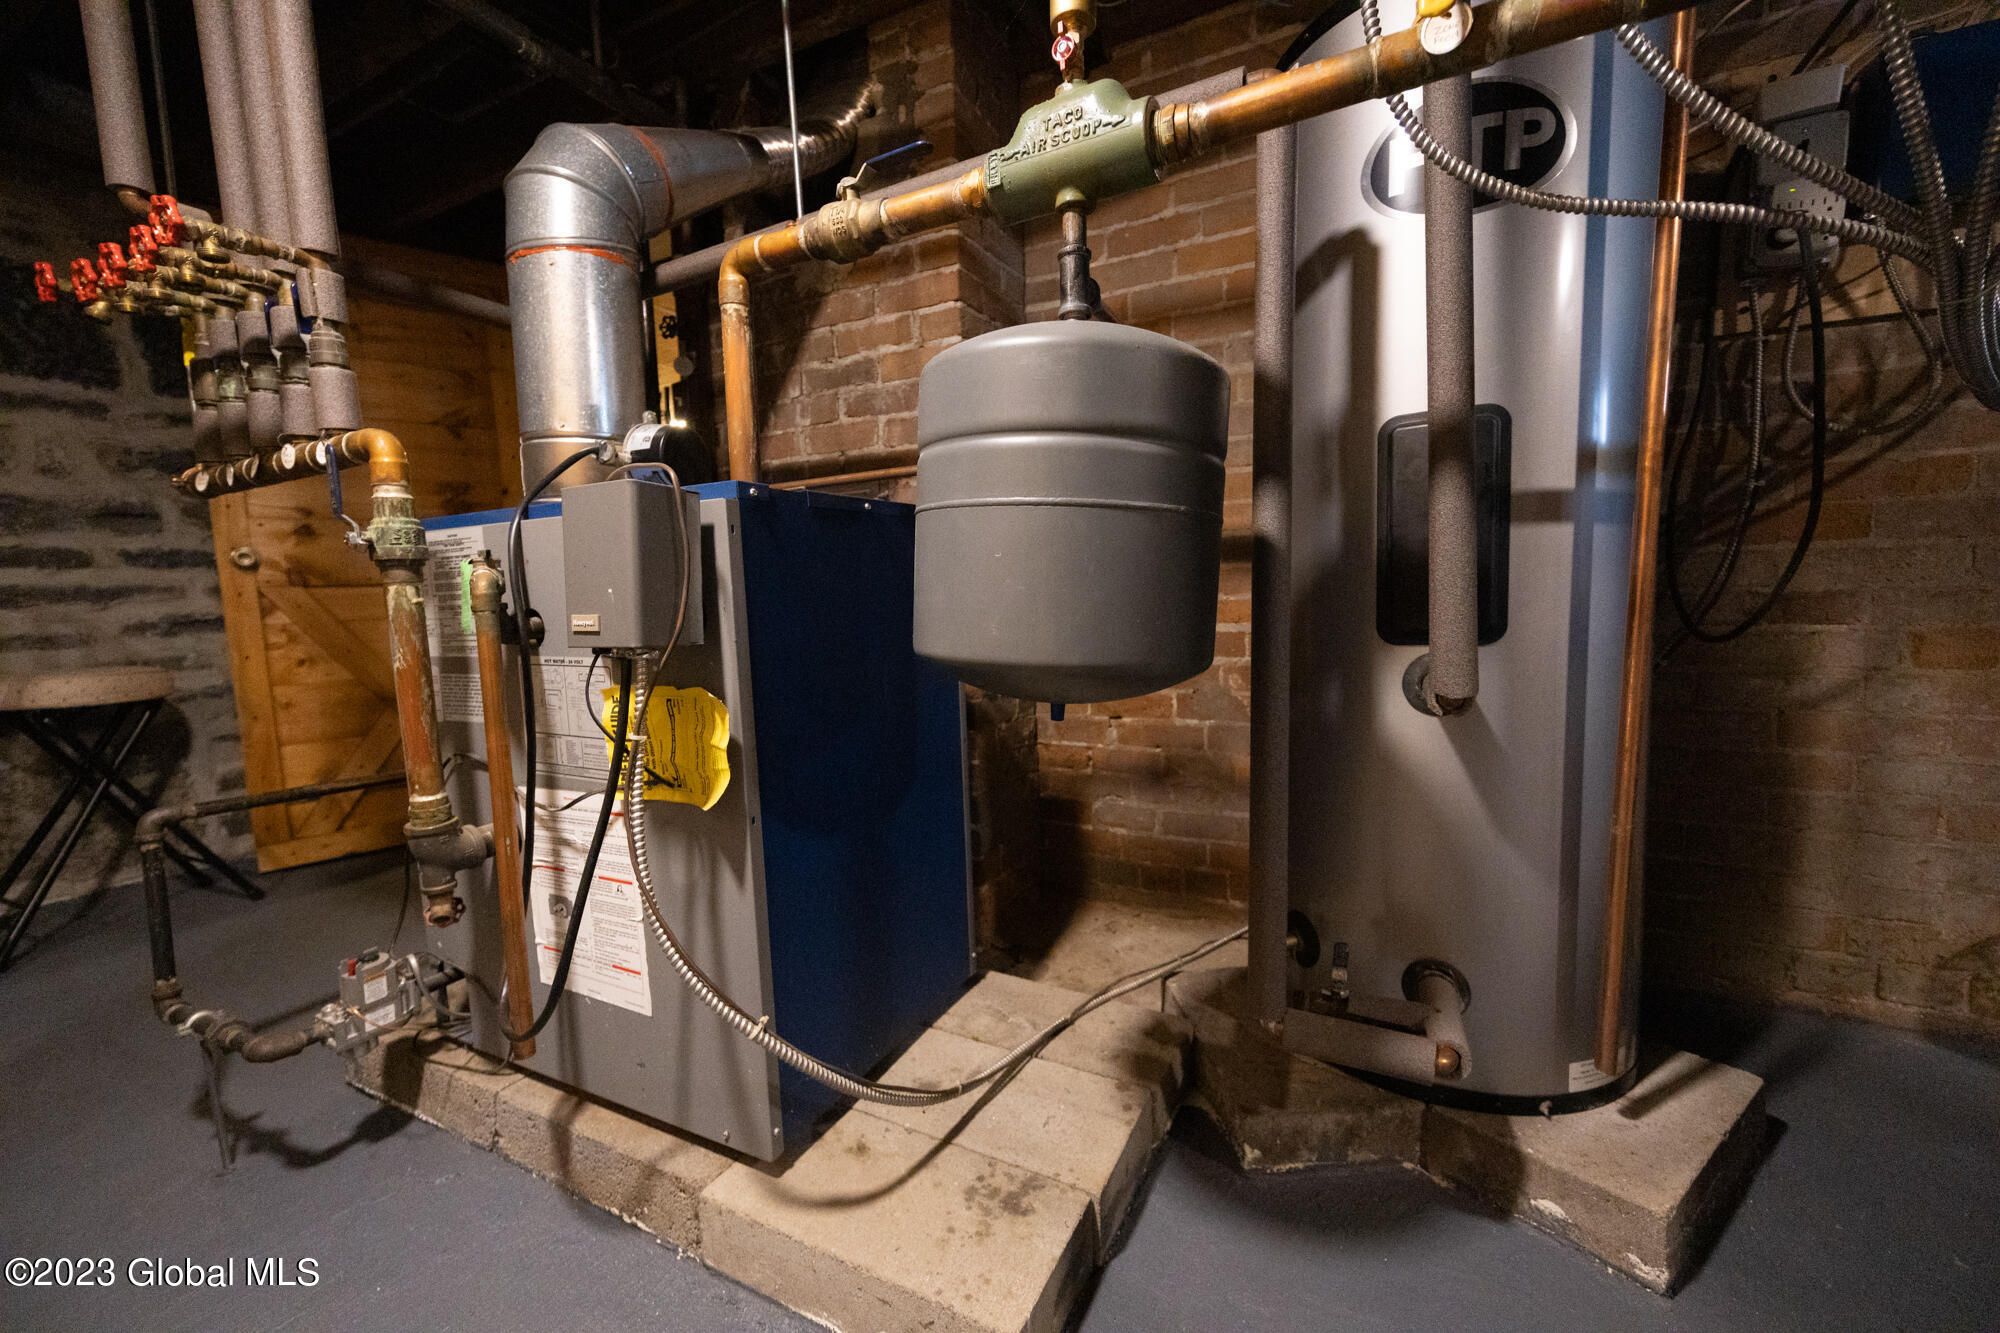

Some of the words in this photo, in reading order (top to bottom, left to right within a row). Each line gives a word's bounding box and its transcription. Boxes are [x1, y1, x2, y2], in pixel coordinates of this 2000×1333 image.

[1043, 105, 1083, 132] TACO
[1020, 137, 1048, 157] AIR
[1050, 118, 1103, 148] SCOOP
